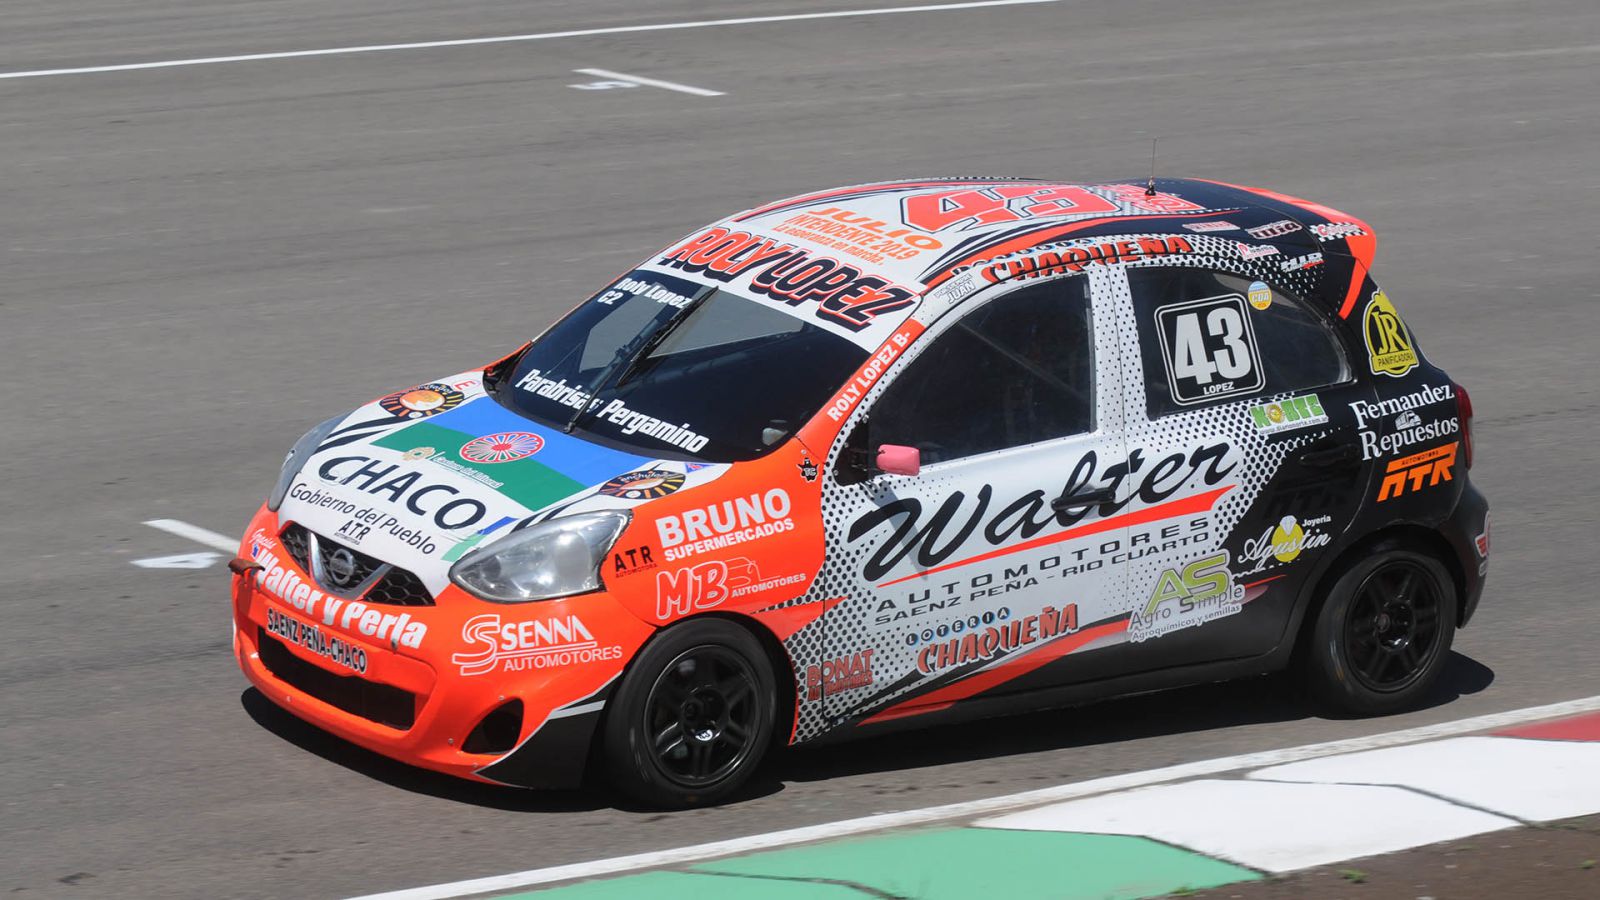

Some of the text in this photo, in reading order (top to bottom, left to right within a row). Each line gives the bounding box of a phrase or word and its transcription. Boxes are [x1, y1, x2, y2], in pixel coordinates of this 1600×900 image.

[808, 207, 943, 250] JULIO
[900, 184, 1121, 234] 43
[784, 214, 920, 260] INTENDENTE 2019
[981, 236, 1195, 284] CHAQUEÑA
[613, 277, 693, 309] Roly Lopez
[657, 226, 797, 282] ROLY
[749, 249, 924, 333] LOPEZ
[947, 279, 976, 304] JUAN
[1174, 307, 1251, 384] 43
[1372, 310, 1409, 355] JR
[827, 384, 862, 422] ROLY
[855, 344, 899, 387] LOPEZ
[1377, 353, 1414, 368] PANIFICADORA
[1203, 382, 1235, 396] LOPEZ
[1349, 383, 1456, 430] Fernandez
[598, 397, 709, 454] Pergamino
[1358, 416, 1459, 461] Repuestos
[318, 455, 487, 530] CHACO
[847, 440, 1237, 582] Walter
[290, 483, 436, 555] Gobierno del Pueblo
[339, 520, 371, 541] ATR
[655, 488, 791, 548] BRUNO
[664, 518, 795, 562] SUPERMERCADOS
[615, 545, 654, 572] ATR
[876, 597, 962, 626] SAENZ
[969, 577, 1038, 602] PEÑA
[1062, 560, 1107, 580] RIO
[1111, 532, 1208, 567] CUARTO
[877, 517, 1208, 612] AUTOMOTORES
[655, 560, 729, 620] MB
[732, 573, 806, 598] AUTOMOTORES
[1142, 553, 1229, 618] AS
[322, 601, 343, 627] y
[341, 602, 428, 649] Perla
[906, 607, 1011, 645] LOTERIA
[1130, 608, 1171, 630] Agro
[1204, 604, 1240, 620] semillas
[267, 608, 368, 675] SAENZ PEÑA-CHACO
[504, 646, 622, 672] AUTOMOTORES
[917, 602, 1079, 674] CHAQUEÑA
